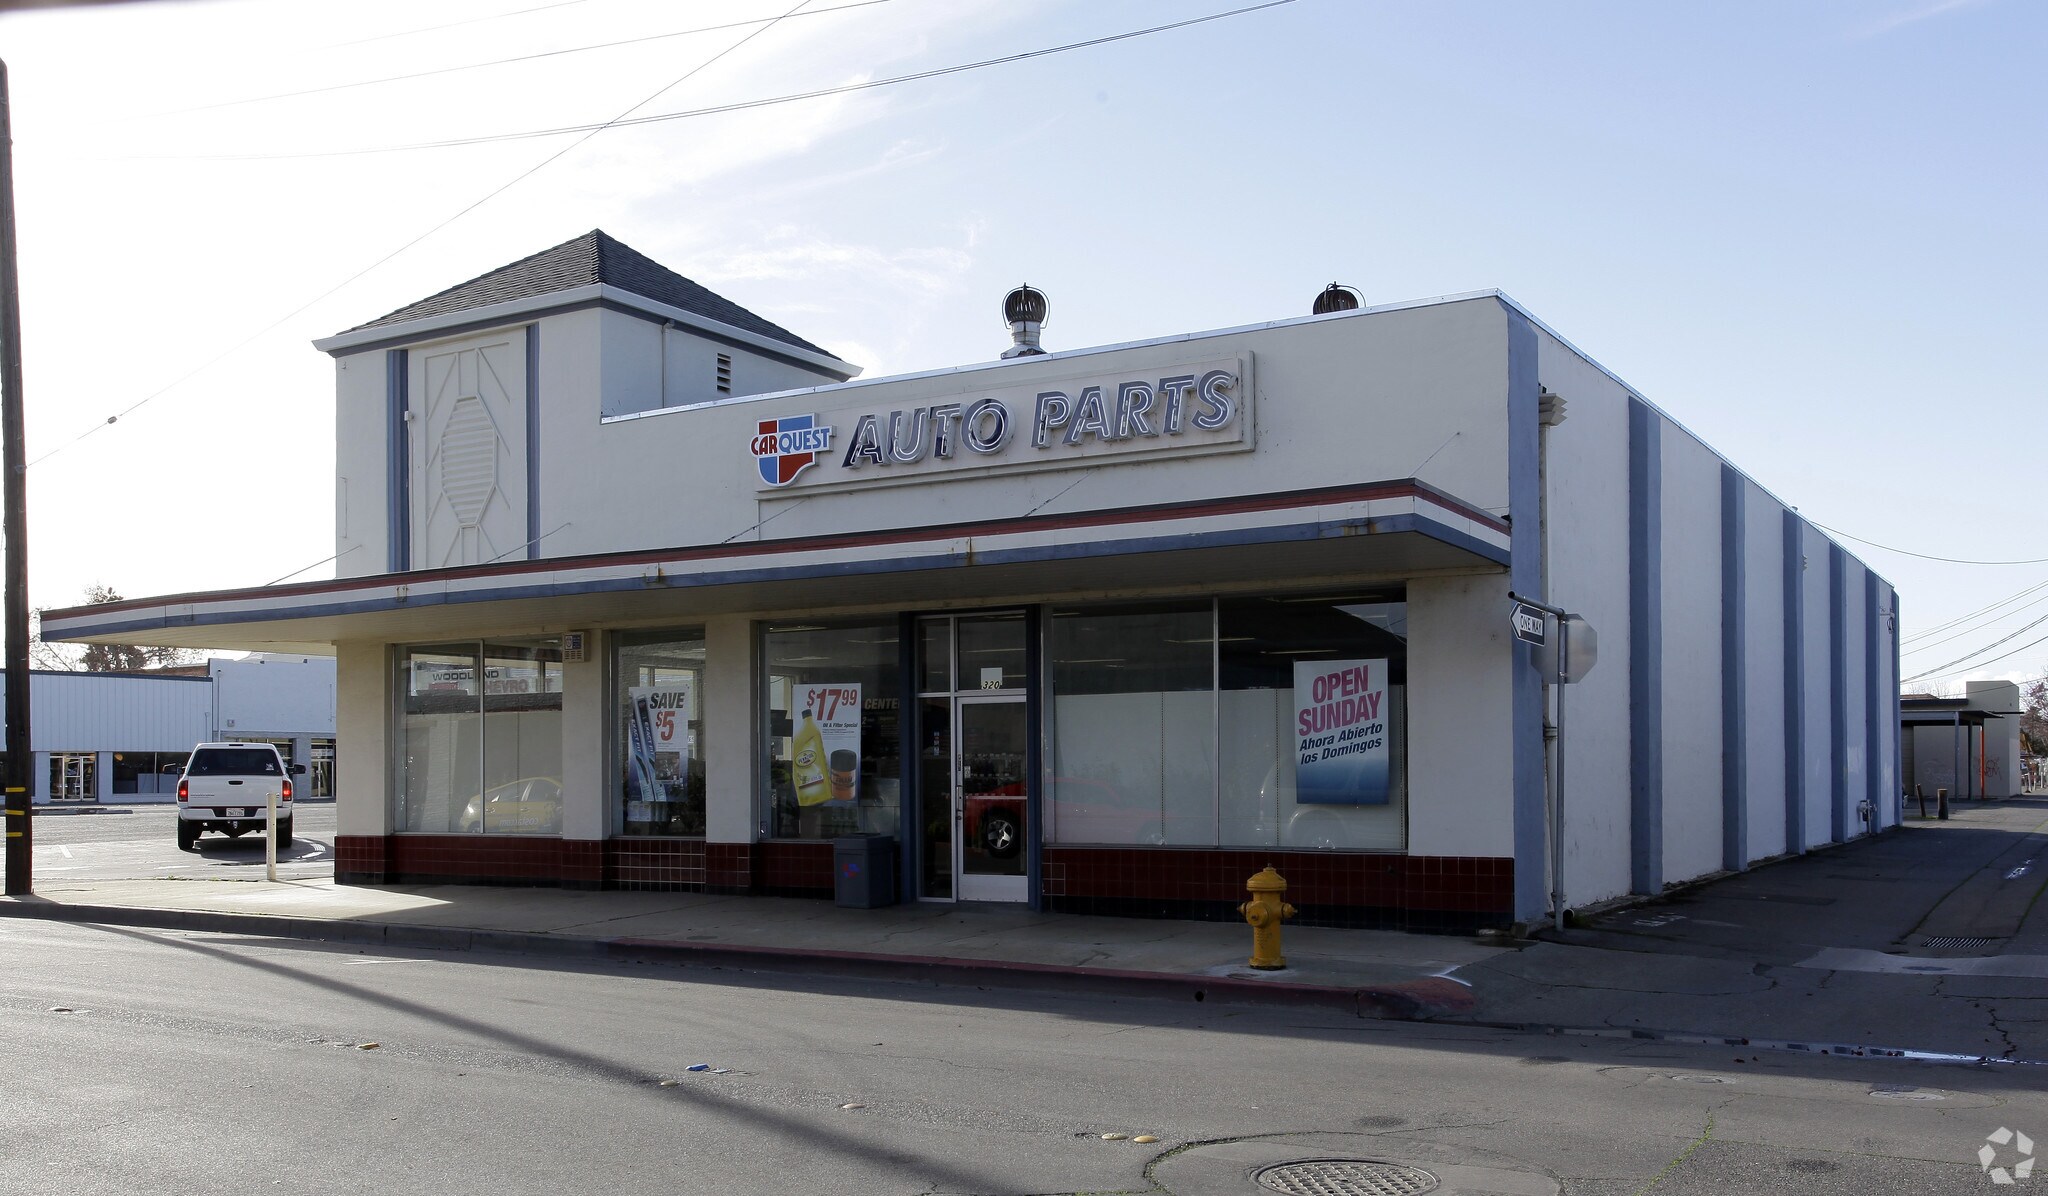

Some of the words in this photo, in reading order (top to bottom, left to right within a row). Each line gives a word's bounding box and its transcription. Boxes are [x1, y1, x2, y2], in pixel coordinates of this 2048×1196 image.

[842, 398, 1015, 469] AUTO
[1030, 369, 1239, 450] PARTS
[751, 428, 830, 455] CARQUEST
[1520, 615, 1531, 631] ONE
[1532, 619, 1542, 635] WAY
[433, 670, 499, 681] WOODLND
[983, 680, 1000, 690] 320
[1312, 665, 1369, 704] OPEN
[649, 692, 685, 709] SAVE
[864, 697, 900, 710] CENTE
[1298, 690, 1383, 736] SUNDAY
[655, 710, 676, 741] $5
[1299, 735, 1334, 752] Ahora
[1338, 723, 1383, 743] Abierto
[1300, 753, 1318, 765] los
[1321, 737, 1382, 761] Domingos
